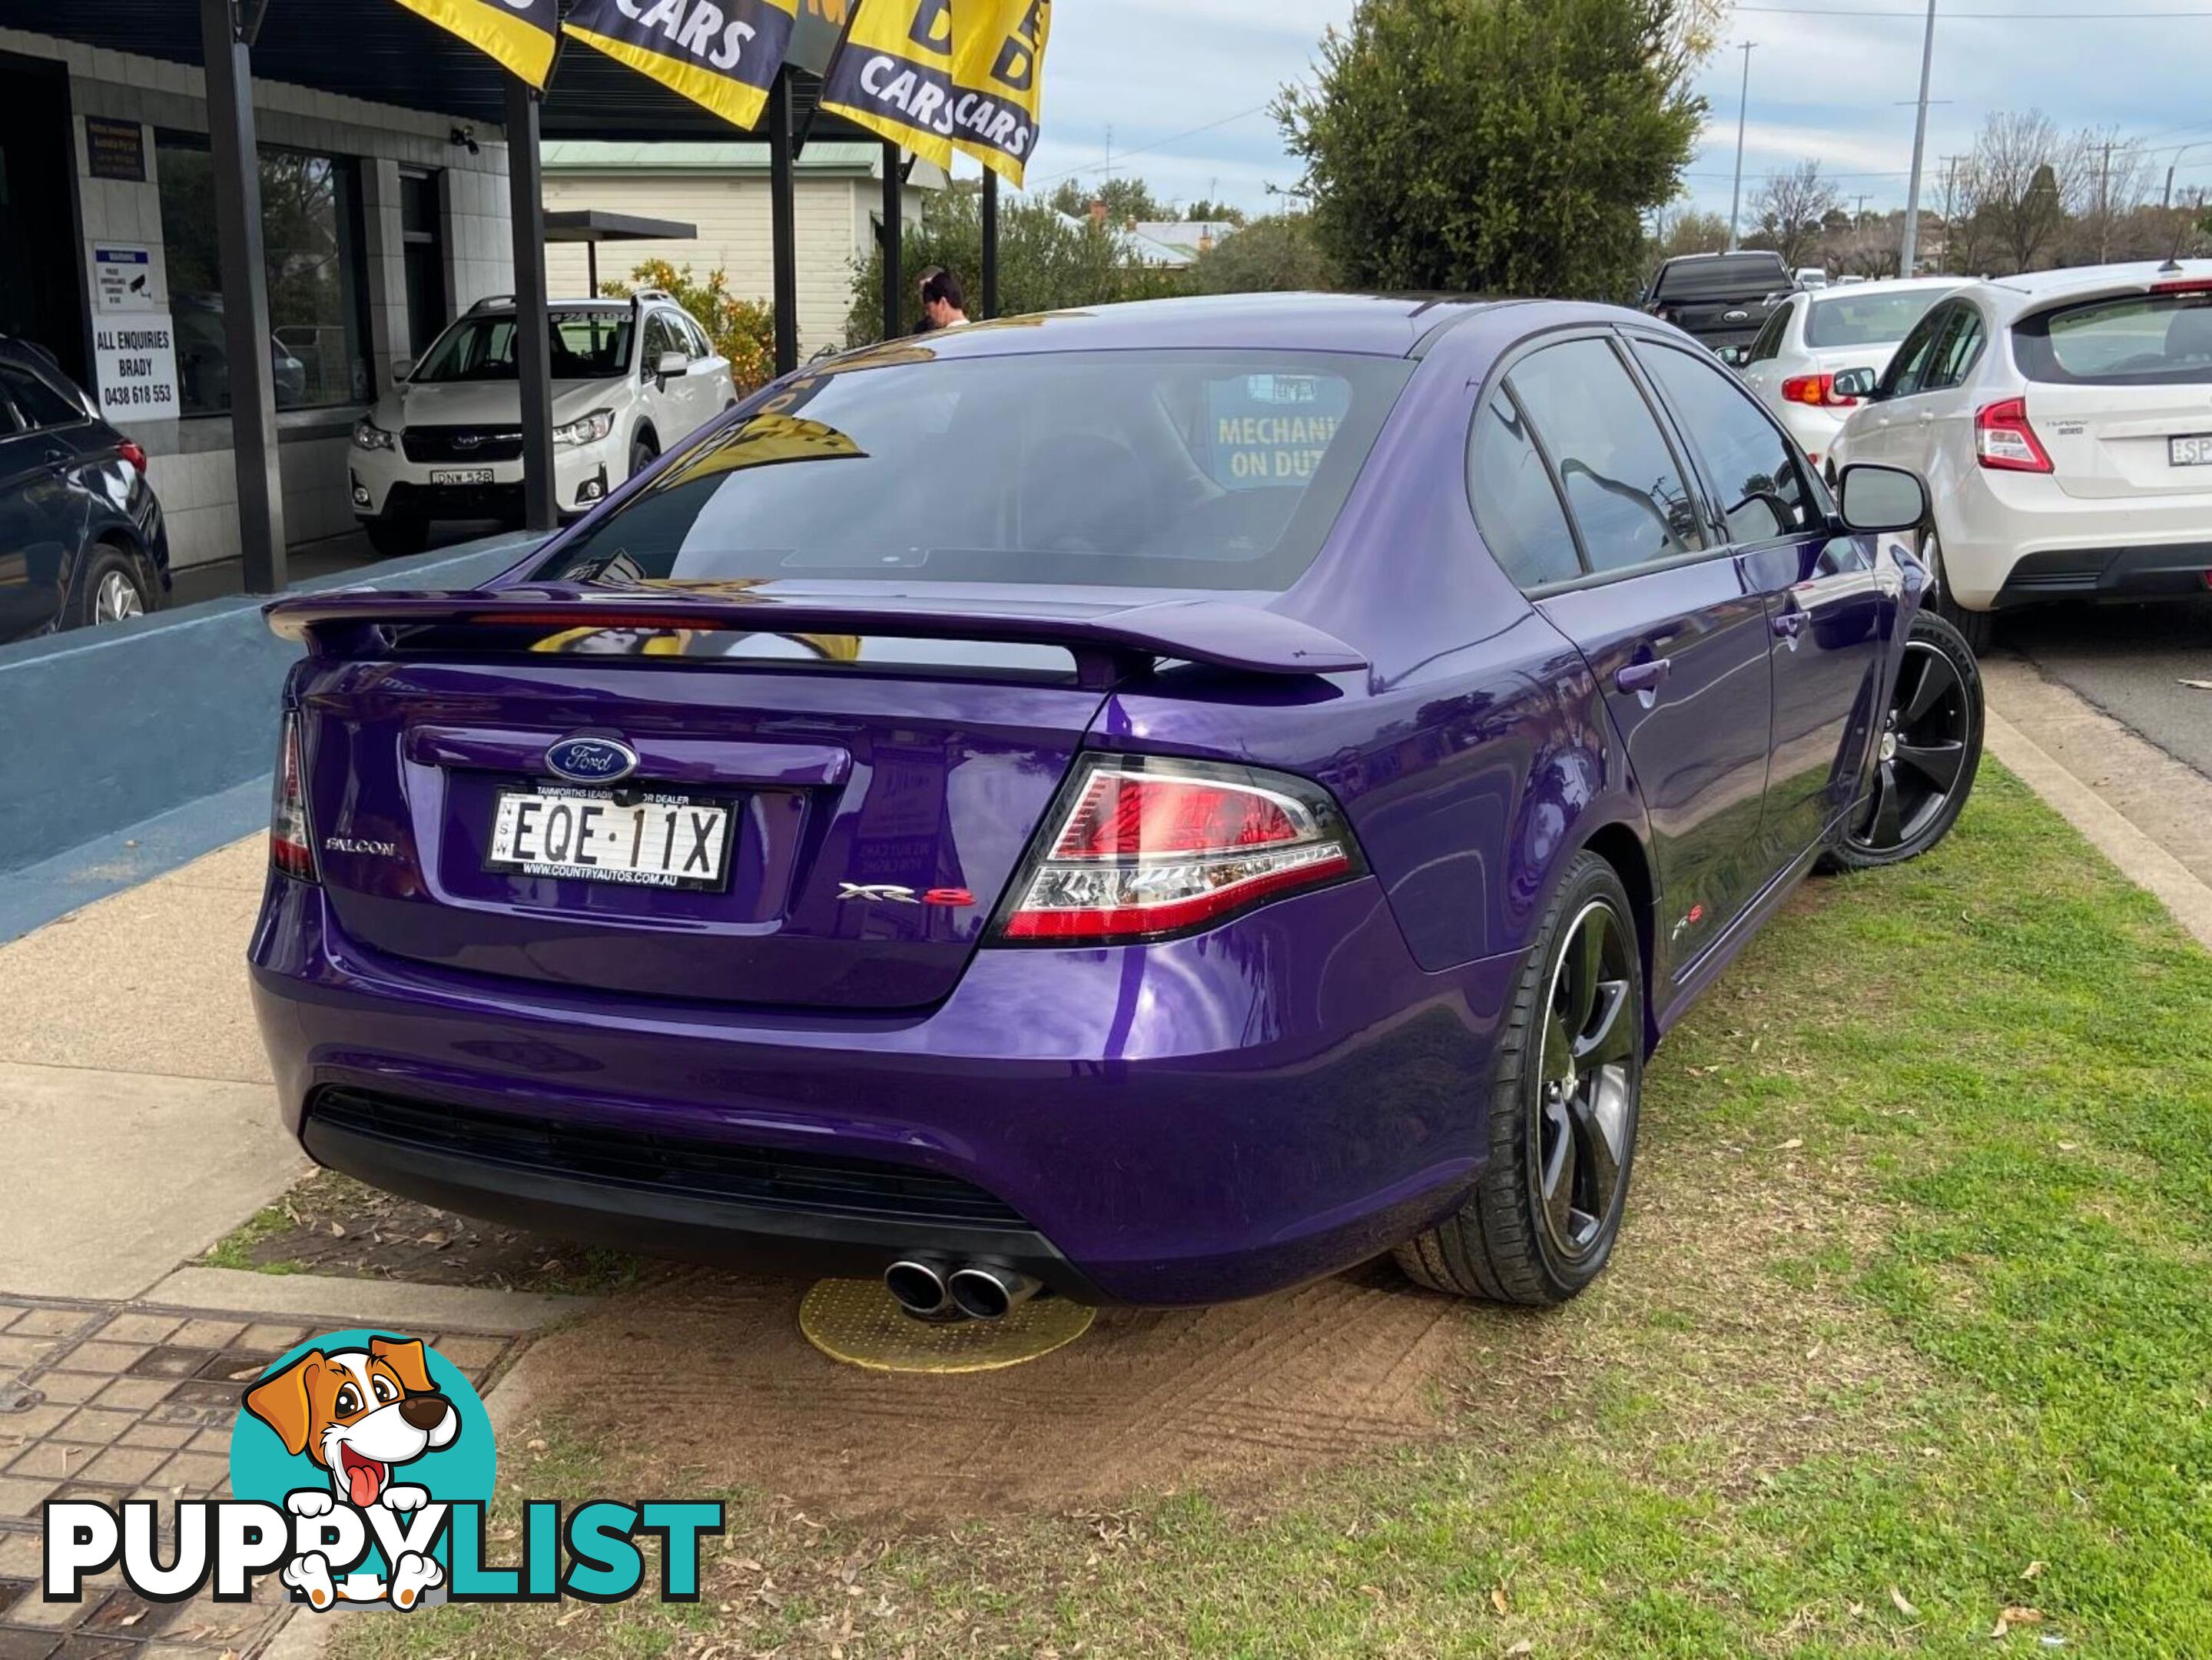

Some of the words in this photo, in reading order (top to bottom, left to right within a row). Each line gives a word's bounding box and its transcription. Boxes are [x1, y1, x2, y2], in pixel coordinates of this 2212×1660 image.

[955, 93, 1029, 155] CARS
[98, 332, 115, 350] ALL
[118, 331, 169, 350] ENQUIRIES
[119, 358, 151, 377] BRADY
[104, 387, 130, 406] 0438
[132, 386, 151, 403] 618
[153, 384, 171, 403] 553
[1219, 417, 1338, 445] MECHANI
[1232, 451, 1267, 477] ON
[1275, 450, 1326, 476] DUT
[565, 744, 614, 771] Ford
[538, 786, 586, 798] TAMWORTHS
[656, 794, 689, 805] DEALER
[326, 838, 395, 856] FALCON
[523, 862, 678, 886] WWW.COUNTRYAUTOS.COM.AU
